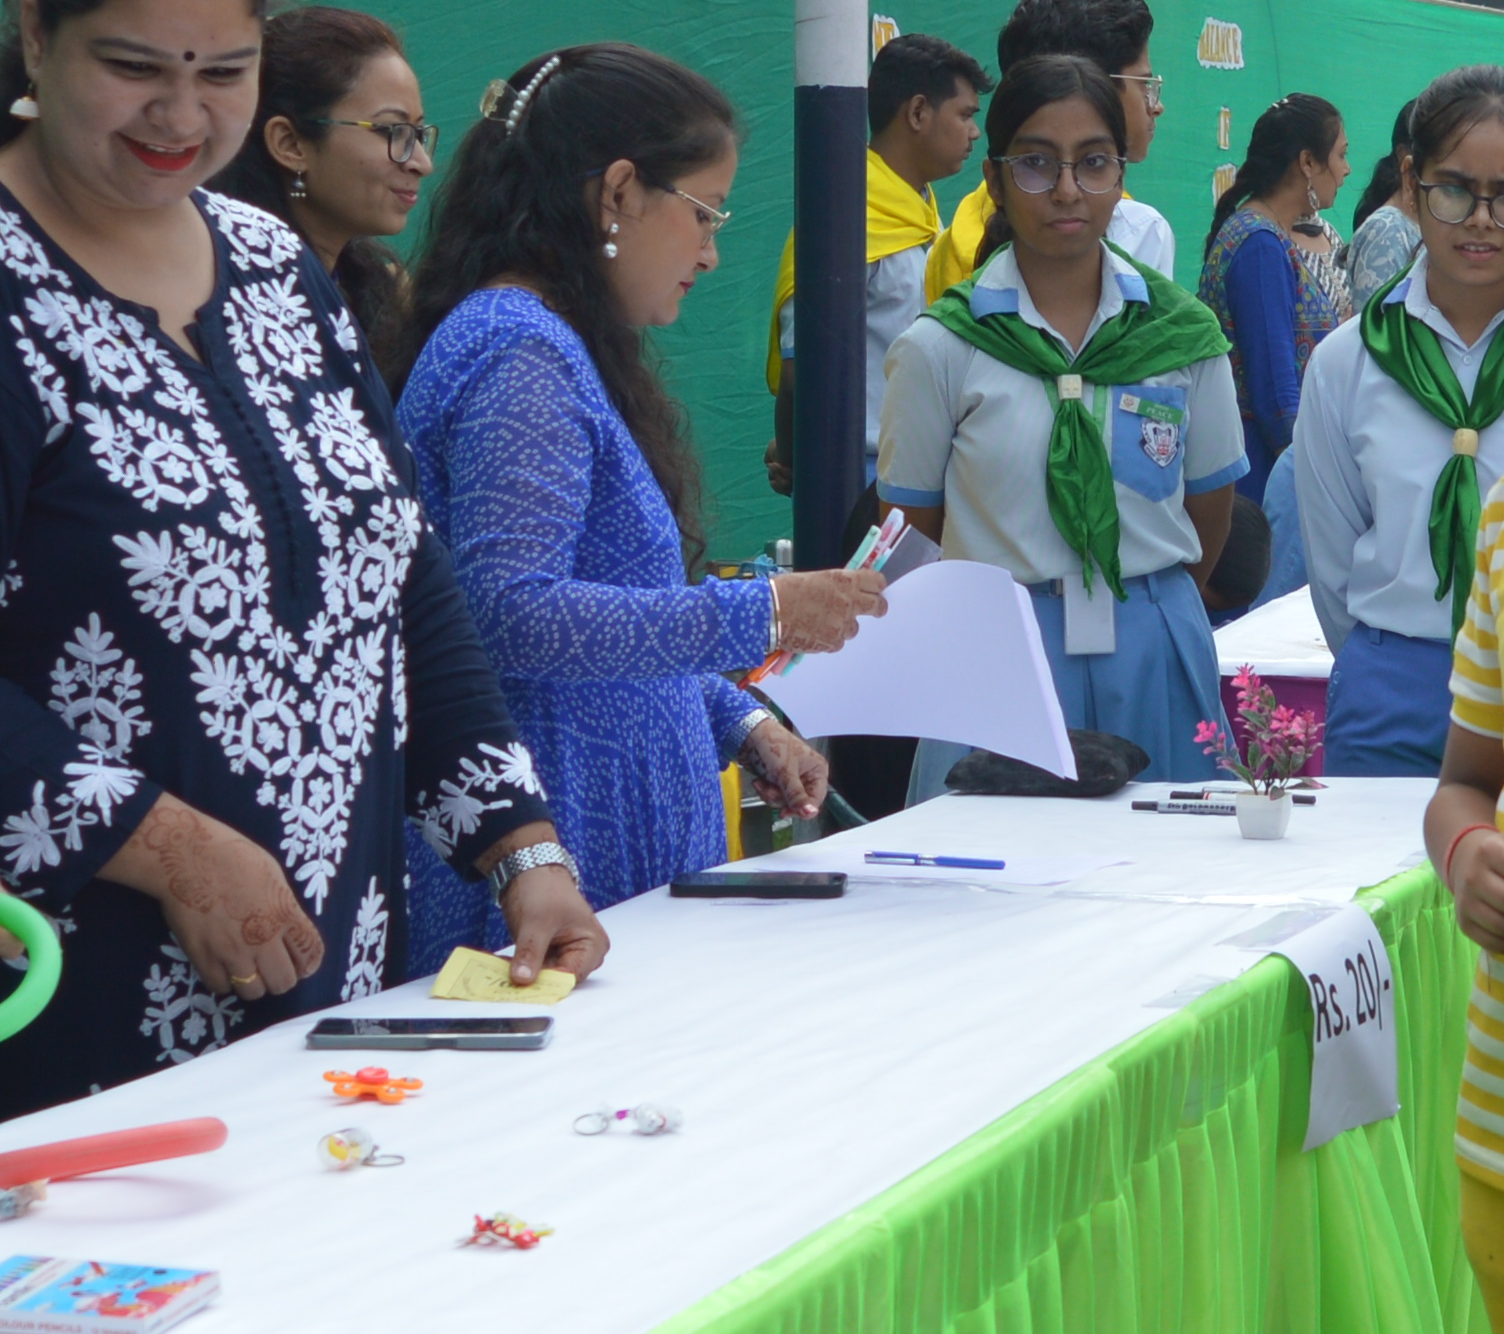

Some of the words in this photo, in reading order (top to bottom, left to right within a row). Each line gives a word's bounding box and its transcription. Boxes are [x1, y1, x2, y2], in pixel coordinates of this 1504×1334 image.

[1146, 406, 1174, 420] PEACE
[1308, 973, 1351, 1043] Rs.
[1344, 939, 1390, 1031] 20/-
